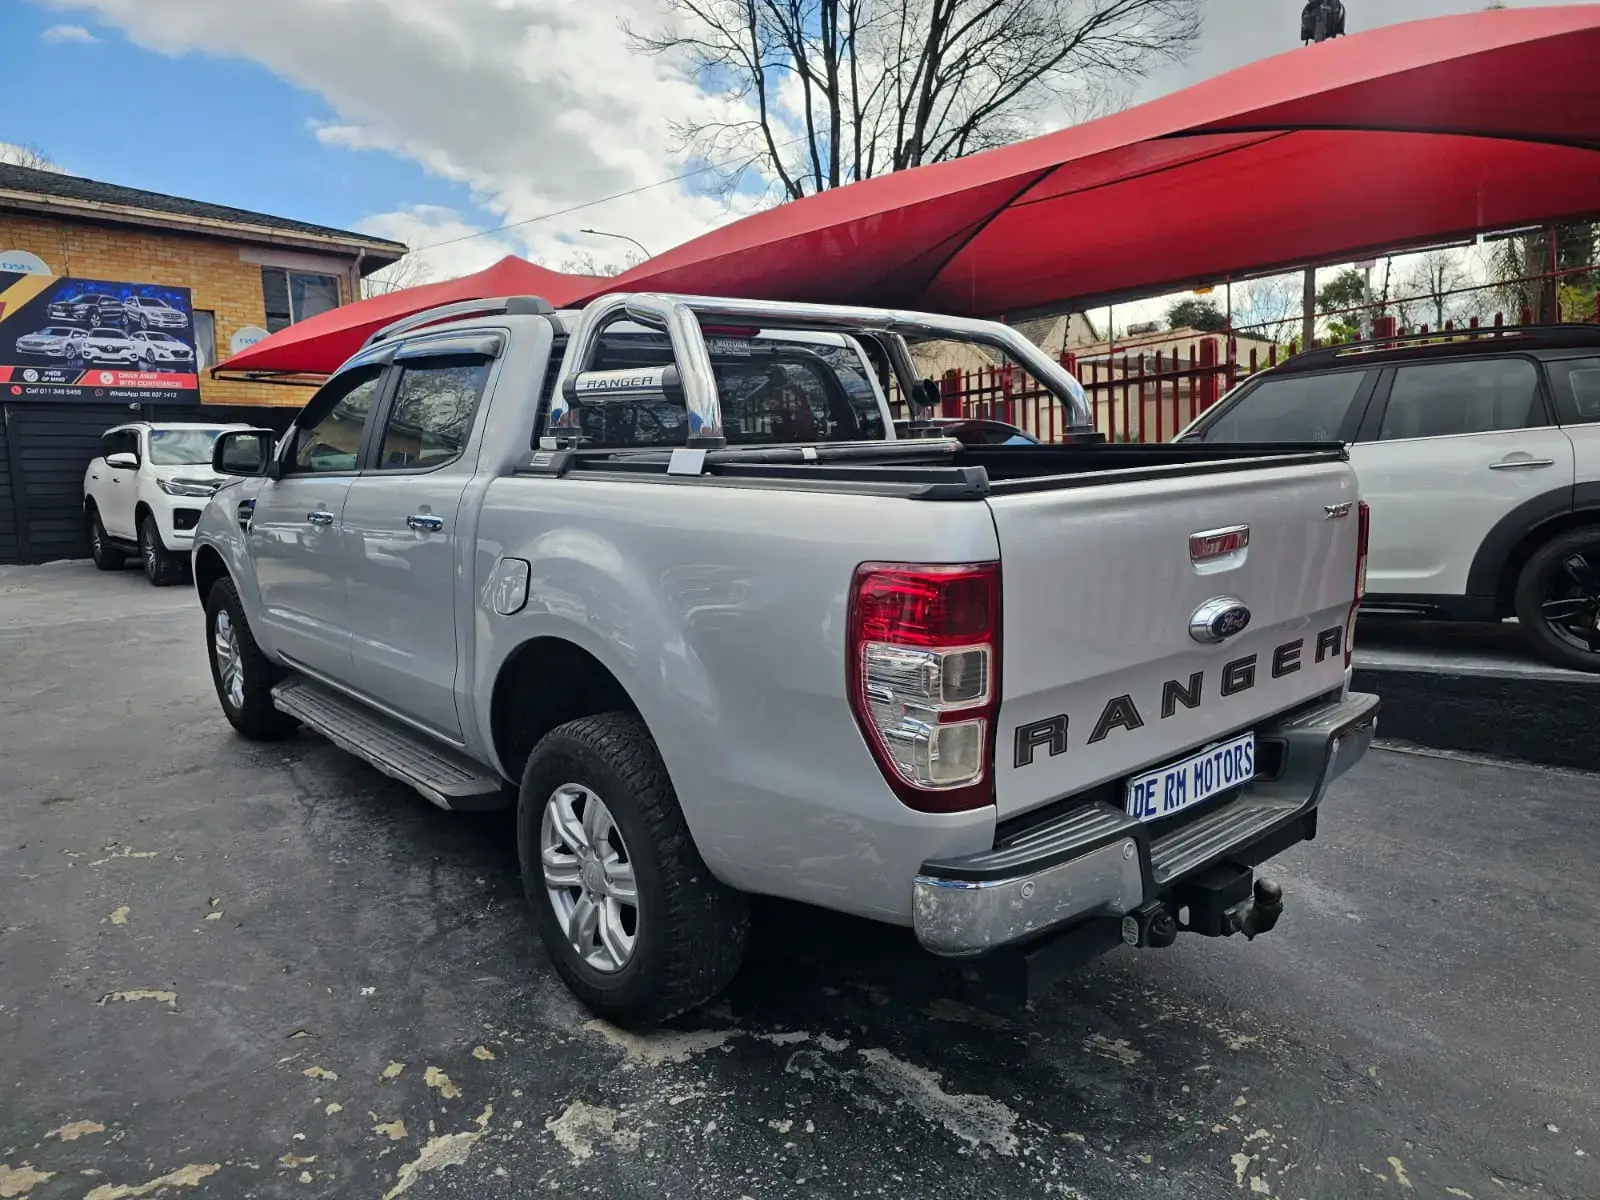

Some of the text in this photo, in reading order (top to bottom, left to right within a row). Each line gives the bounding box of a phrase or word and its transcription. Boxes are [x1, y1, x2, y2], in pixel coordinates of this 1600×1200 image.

[109, 390, 139, 398] WhatsApp
[587, 376, 653, 389] RANGER
[1013, 625, 1343, 769] RANGER
[1133, 741, 1253, 819] DE RM MOTORS
